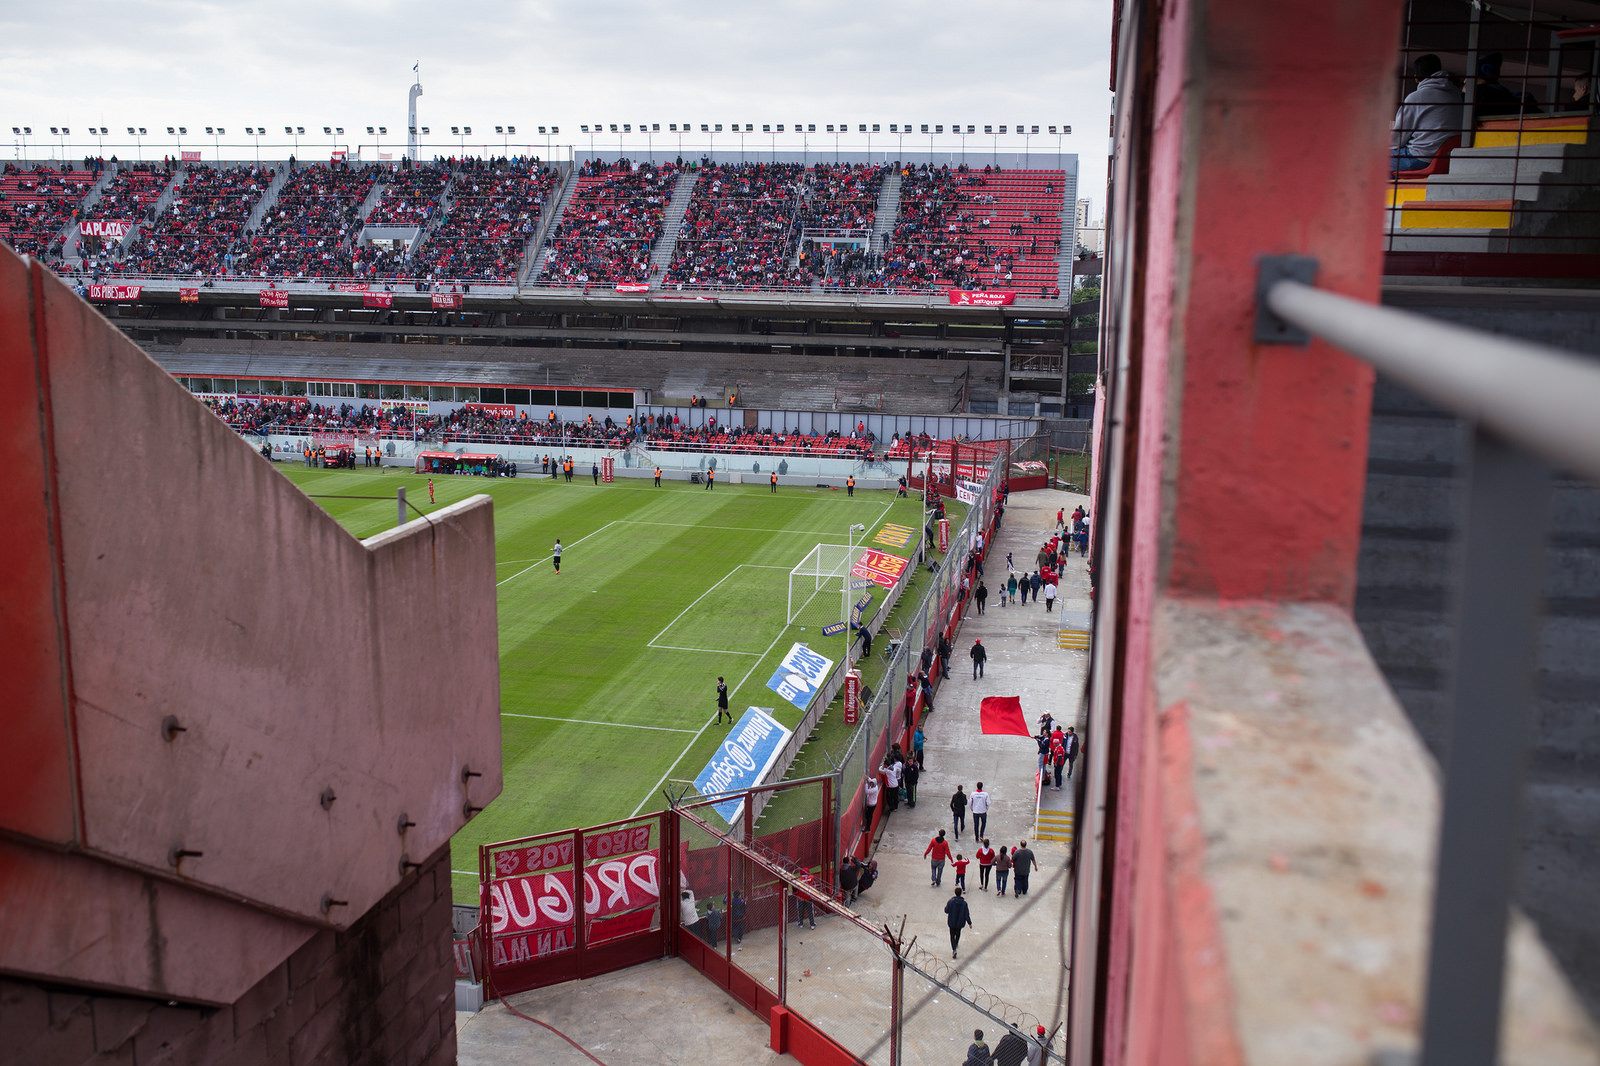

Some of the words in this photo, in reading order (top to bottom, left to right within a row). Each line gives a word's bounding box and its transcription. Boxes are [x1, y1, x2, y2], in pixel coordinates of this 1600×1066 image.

[80, 222, 93, 235] LA
[93, 222, 123, 236] PLATA
[90, 286, 101, 298] LOS
[101, 286, 119, 299] PIBES
[126, 286, 140, 299] SUR
[824, 626, 833, 635] LA
[831, 622, 847, 633] NUEVA
[736, 713, 773, 753] Allianz
[702, 756, 744, 801] Seguros
